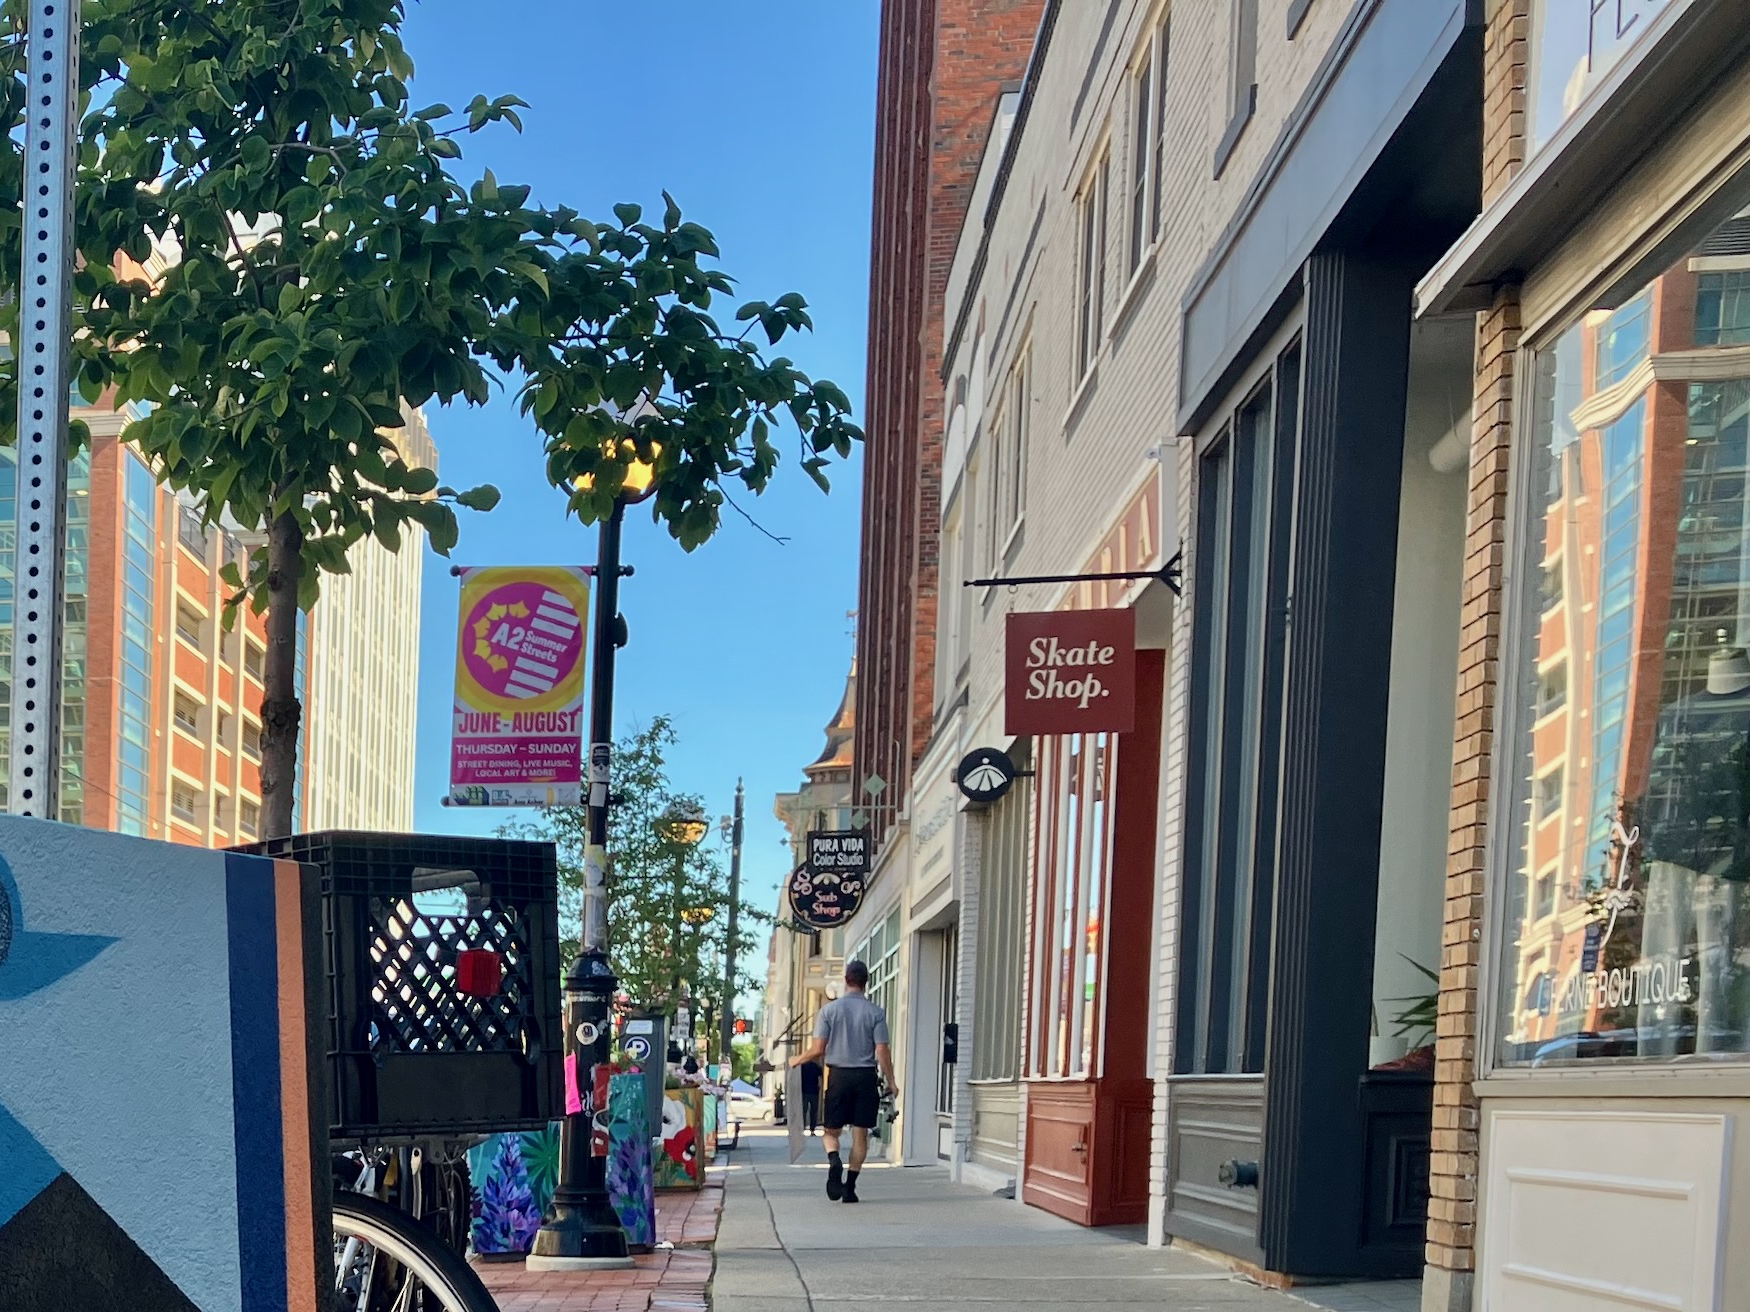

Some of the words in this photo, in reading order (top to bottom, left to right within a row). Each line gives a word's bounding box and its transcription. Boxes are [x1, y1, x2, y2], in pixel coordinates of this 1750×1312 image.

[491, 622, 526, 651] A2
[525, 630, 568, 653] Summer
[520, 642, 558, 663] Streets
[1025, 636, 1114, 669] Skate
[1025, 669, 1111, 709] Shop.
[458, 712, 501, 734] JUNE
[512, 711, 579, 734] AUGUST
[456, 743, 518, 755] THURSDAY
[528, 743, 577, 754] SUNDAY
[457, 760, 488, 769] STREET
[488, 760, 522, 769] DINING,
[523, 760, 542, 768] LIVE
[543, 759, 573, 768] MUSIC,
[475, 769, 502, 777] LOCAL
[504, 769, 521, 777] ART
[813, 838, 839, 852] PURA
[841, 838, 864, 852] VIDA
[813, 853, 836, 866] Color
[837, 852, 864, 866] Studio
[1597, 958, 1691, 1010] BOUTIQUE
